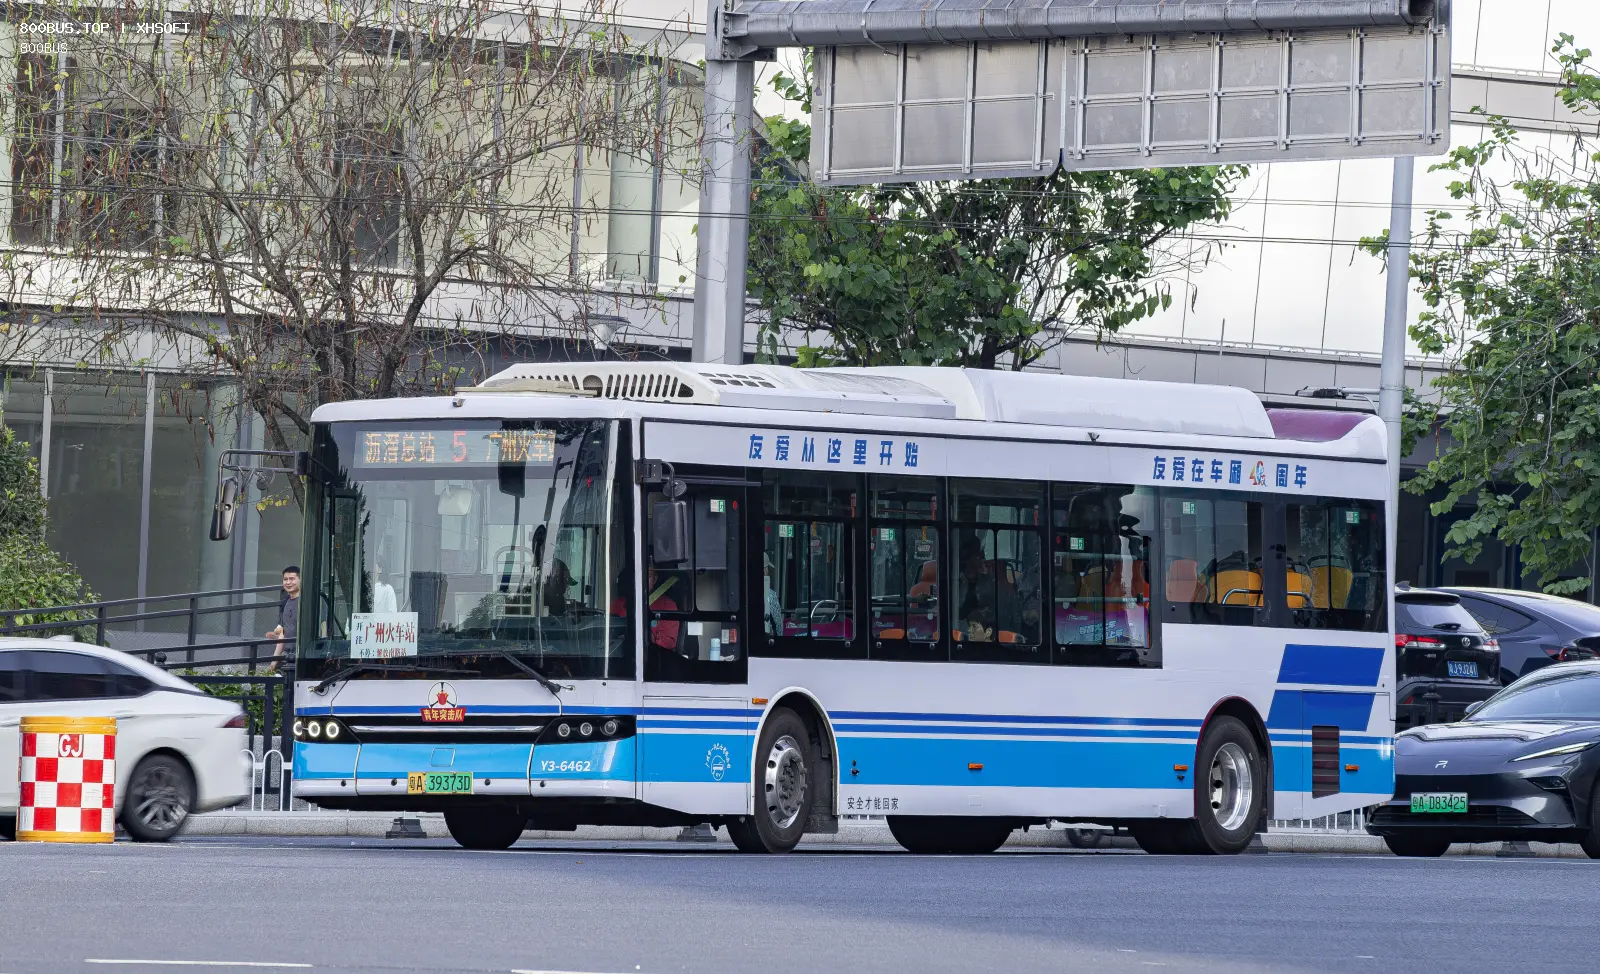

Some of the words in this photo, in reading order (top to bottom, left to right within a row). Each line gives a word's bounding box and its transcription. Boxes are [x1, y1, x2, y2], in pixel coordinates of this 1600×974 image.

[452, 430, 468, 463] 5
[748, 433, 919, 468] 友爱从这里开始
[364, 621, 416, 644] 广州火车站
[423, 708, 464, 721] 青年突击队
[58, 733, 83, 757] GJ
[540, 760, 592, 772] Y3-6462
[847, 796, 900, 811] 安全才能回家
